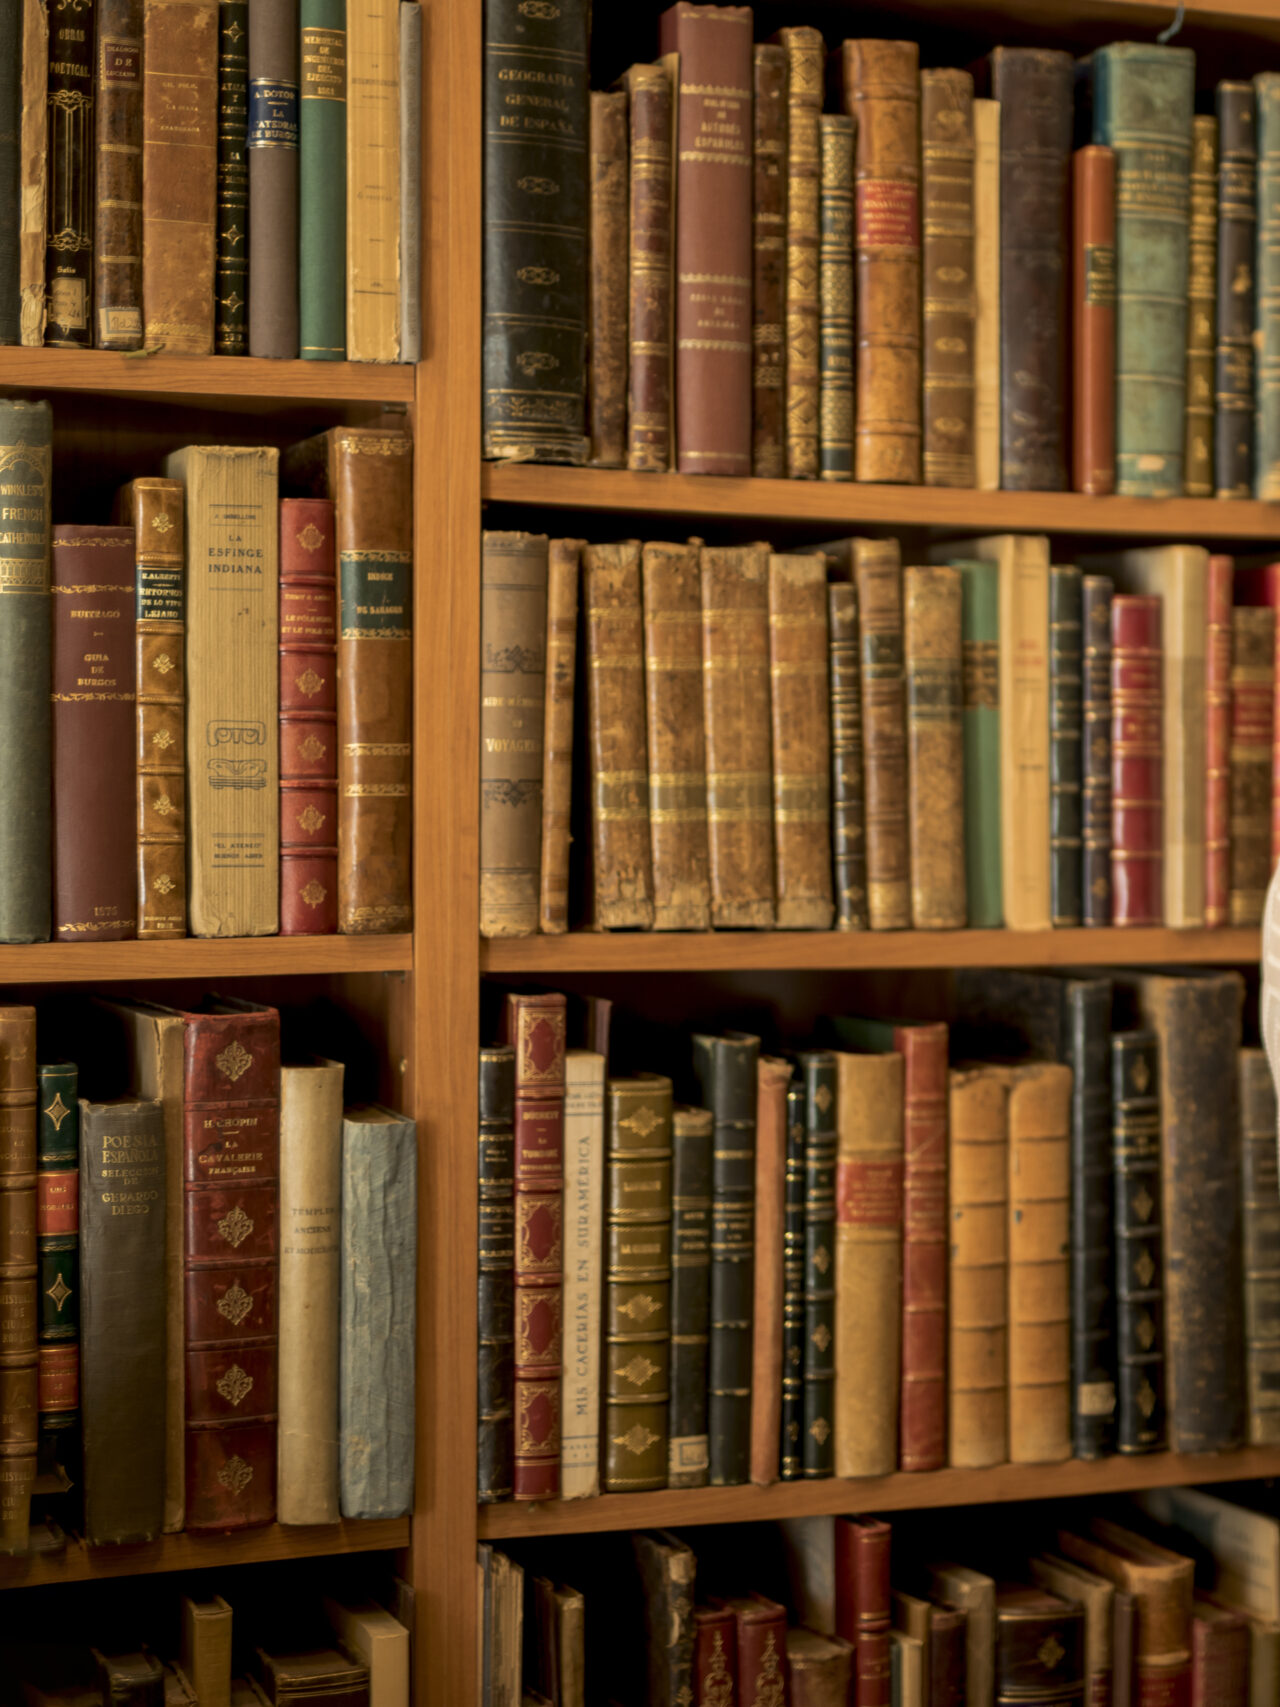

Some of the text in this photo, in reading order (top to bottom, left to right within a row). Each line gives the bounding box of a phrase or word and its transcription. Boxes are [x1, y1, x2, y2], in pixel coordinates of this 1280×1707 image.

[59, 28, 86, 41] OBRAS
[114, 58, 134, 67] DE
[272, 109, 285, 117] LA
[500, 115, 520, 129] DE
[2, 507, 44, 520] FRENCH
[208, 547, 264, 558] ESFINGE
[208, 564, 263, 574] INDIANA
[144, 610, 179, 619] LEJANO
[292, 626, 303, 634] LE
[91, 665, 105, 674] DE
[77, 678, 118, 687] BURGOS
[224, 1141, 239, 1149] LA
[102, 1149, 159, 1164] ESPAÑOLA
[198, 1152, 264, 1165] CAVALERIE
[123, 1176, 138, 1185] DE
[101, 1190, 159, 1203] GERARDO
[111, 1204, 150, 1216] DIEGO
[577, 1259, 589, 1282] EN
[576, 1386, 589, 1416] MIS
